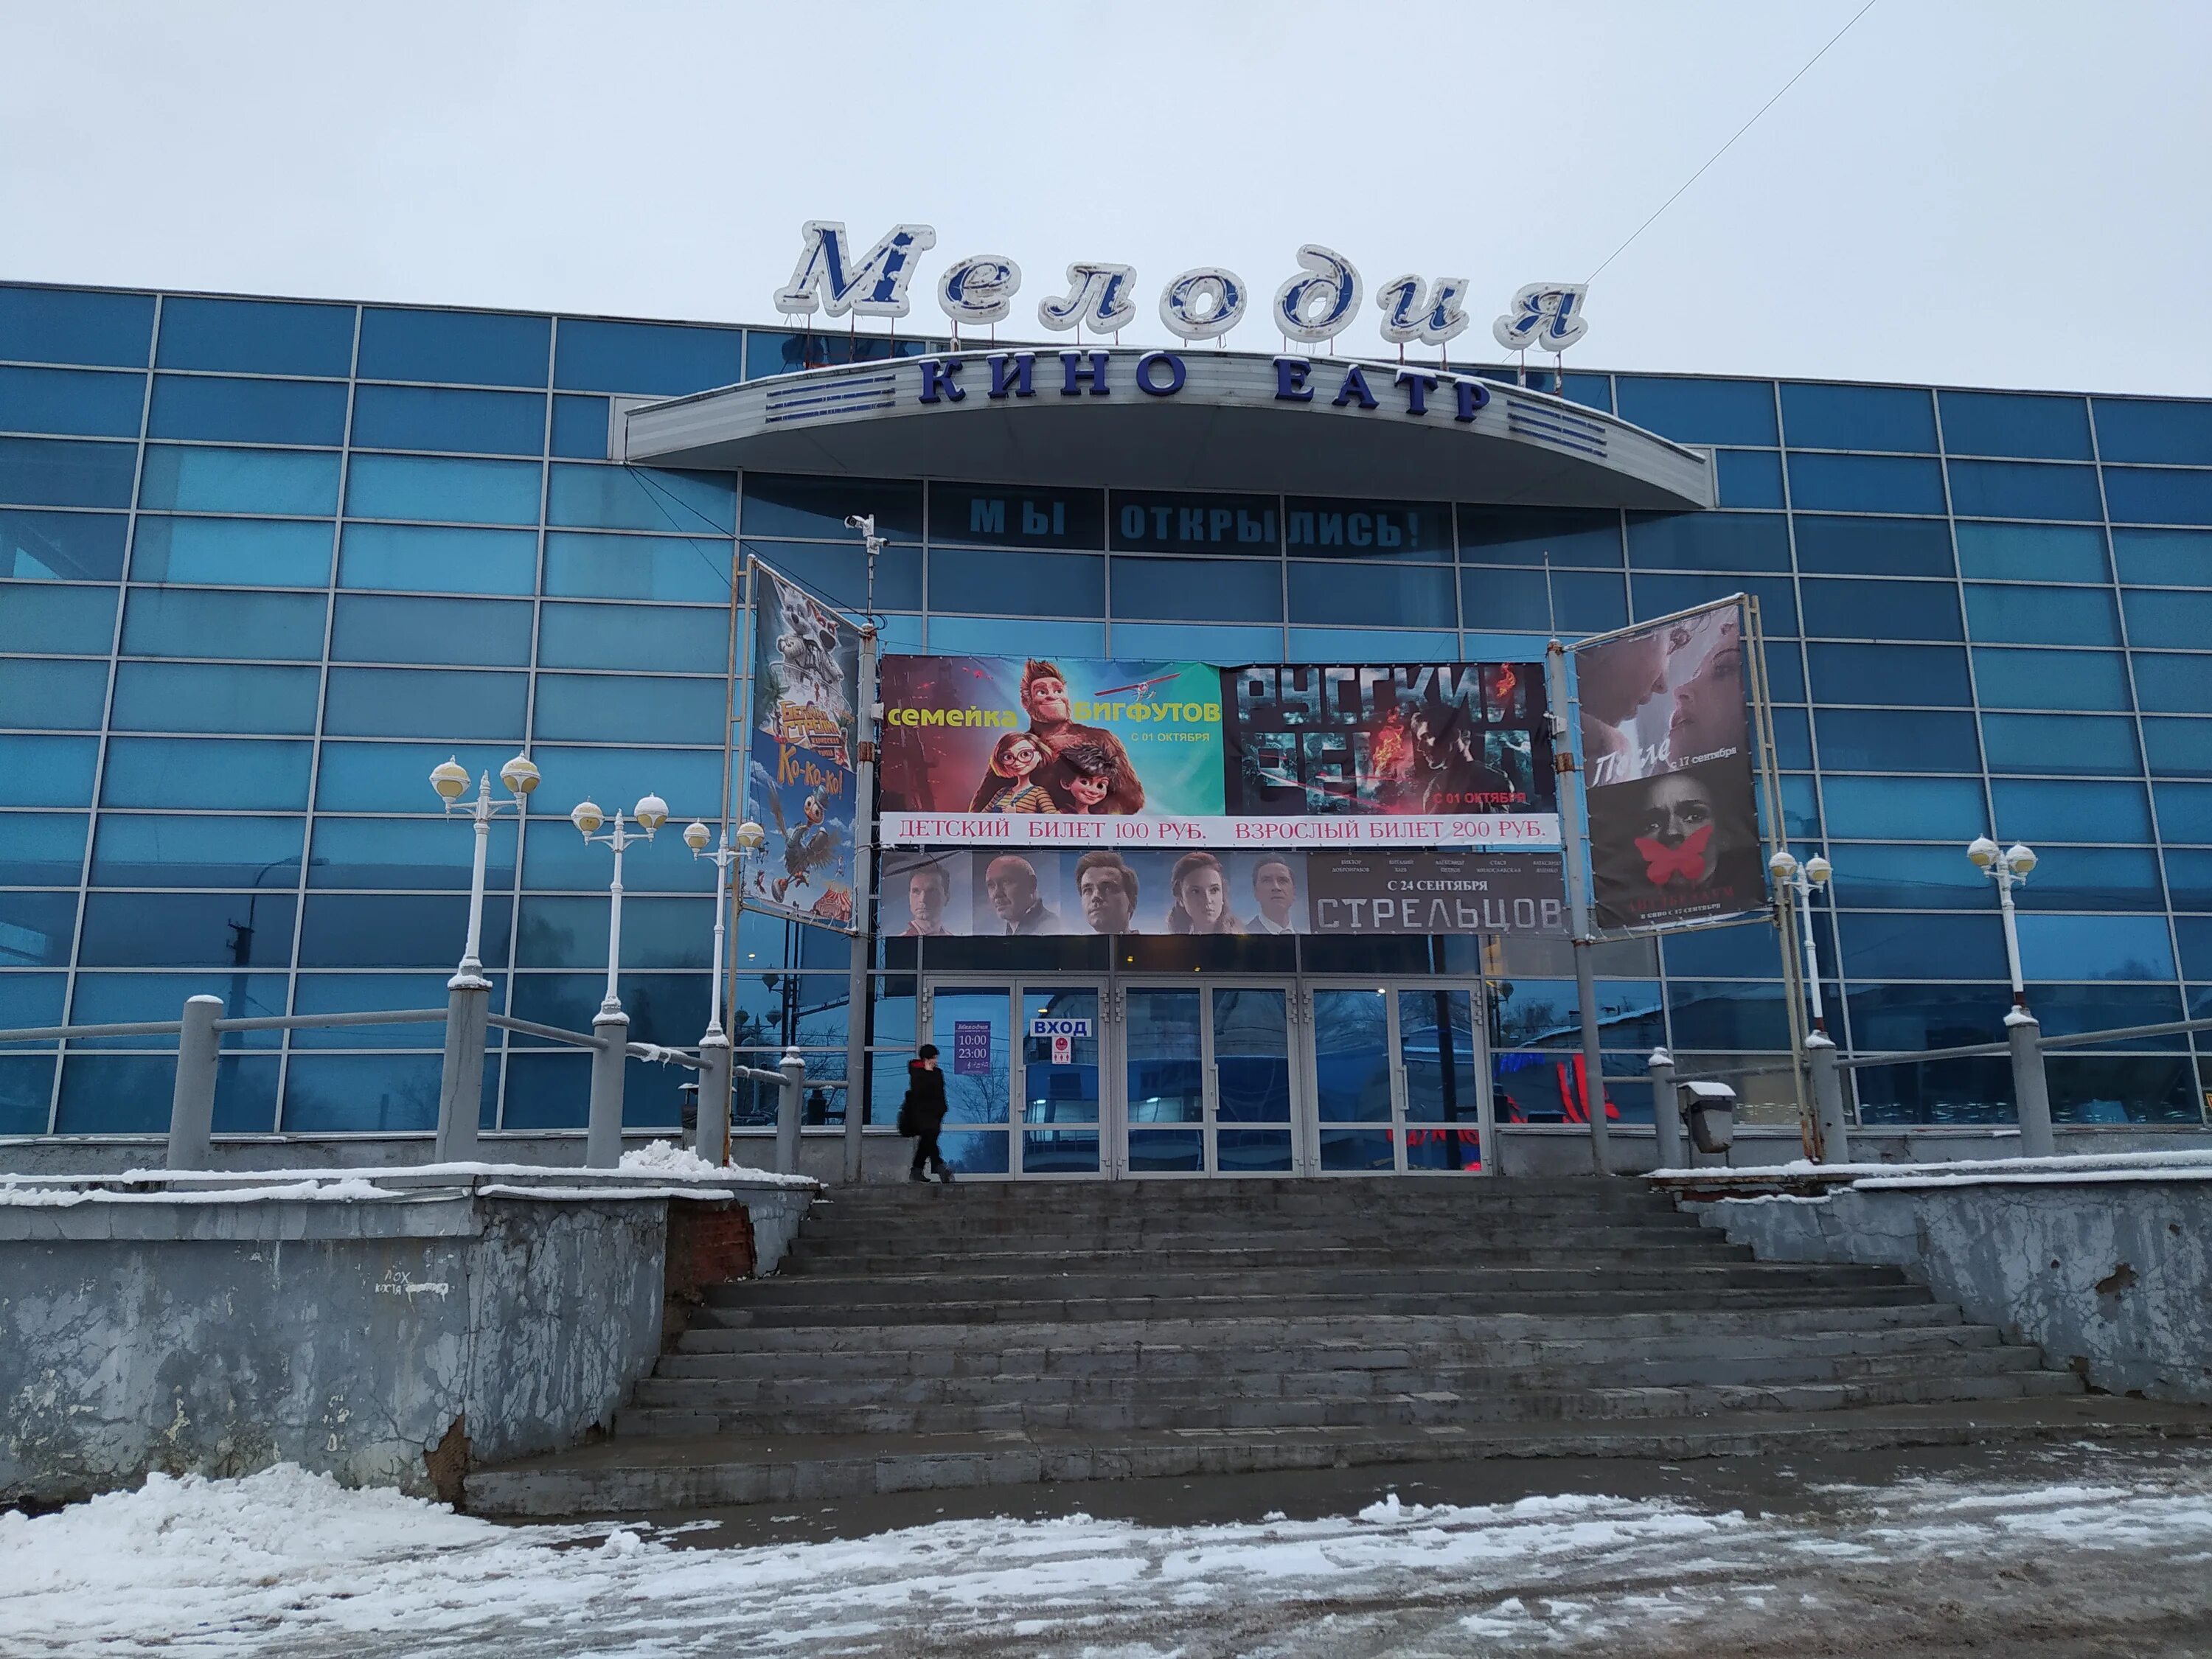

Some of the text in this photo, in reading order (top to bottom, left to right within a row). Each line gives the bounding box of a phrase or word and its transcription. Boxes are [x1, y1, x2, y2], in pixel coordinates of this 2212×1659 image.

[773, 219, 1588, 352] Мелодия
[970, 498, 1420, 548] МЫ ОТКРЫЛИСЬ!
[1074, 701, 1221, 723] БИГФУТОВ
[1131, 732, 1210, 742] С 01 ОКТЯБРЯ
[1679, 756, 1690, 767] 17
[1691, 745, 1737, 764] сентября
[1446, 793, 1461, 804] 01
[1464, 793, 1527, 804] ОКТЯБРЯ
[899, 818, 1547, 841] ДЕТСКИЙ БИЛЕТ 100 РУБ. ВЗРОСЛЫЙ БИЛЕТ 200 РУБ.
[1387, 880, 1488, 891] С 24 СЕНТЯБРЯ
[1317, 897, 1562, 931] СТРЕЛЬЦОВ
[1034, 1021, 1088, 1037] ВХОД
[959, 1035, 987, 1046] 10:00
[959, 1048, 987, 1059] 23:00
